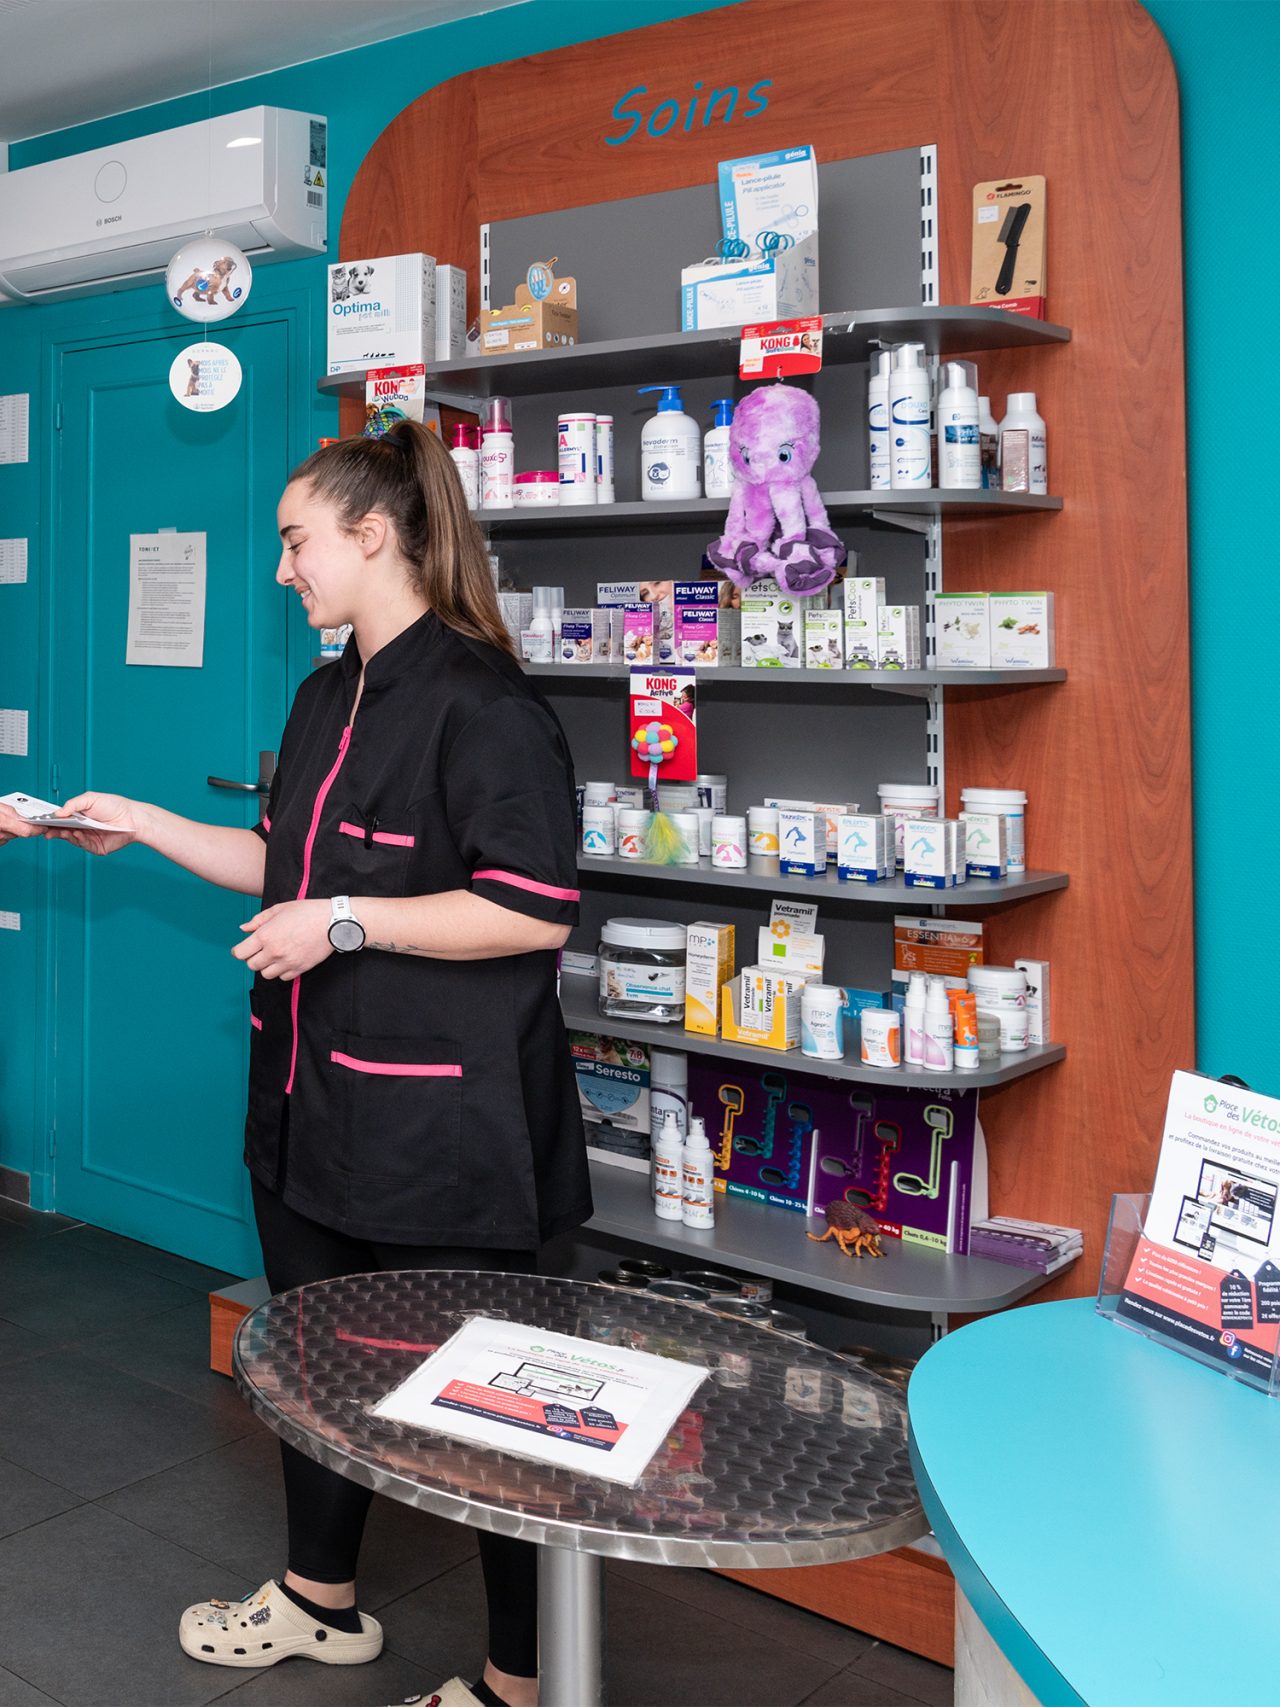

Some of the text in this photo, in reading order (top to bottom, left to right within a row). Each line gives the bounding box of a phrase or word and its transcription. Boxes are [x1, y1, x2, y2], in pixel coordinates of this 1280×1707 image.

[604, 79, 773, 145] Soins
[996, 190, 1032, 200] FLAMINGO
[103, 215, 123, 225] BOSCH
[332, 301, 381, 319] Optima
[760, 337, 791, 351] KONG
[598, 584, 636, 595] FELIWAY
[675, 586, 717, 594] FELIWAY
[694, 593, 716, 601] Classic
[682, 610, 716, 618] FELIWAY
[646, 677, 677, 691] KONG
[649, 689, 674, 698] Active
[774, 903, 815, 917] Vetramil
[625, 982, 659, 991] Observance
[743, 973, 751, 1010] Vetramil
[764, 979, 772, 1014] Vetramil
[595, 1064, 641, 1082] Seresto
[1219, 1100, 1239, 1112] Place
[1226, 1111, 1240, 1122] des
